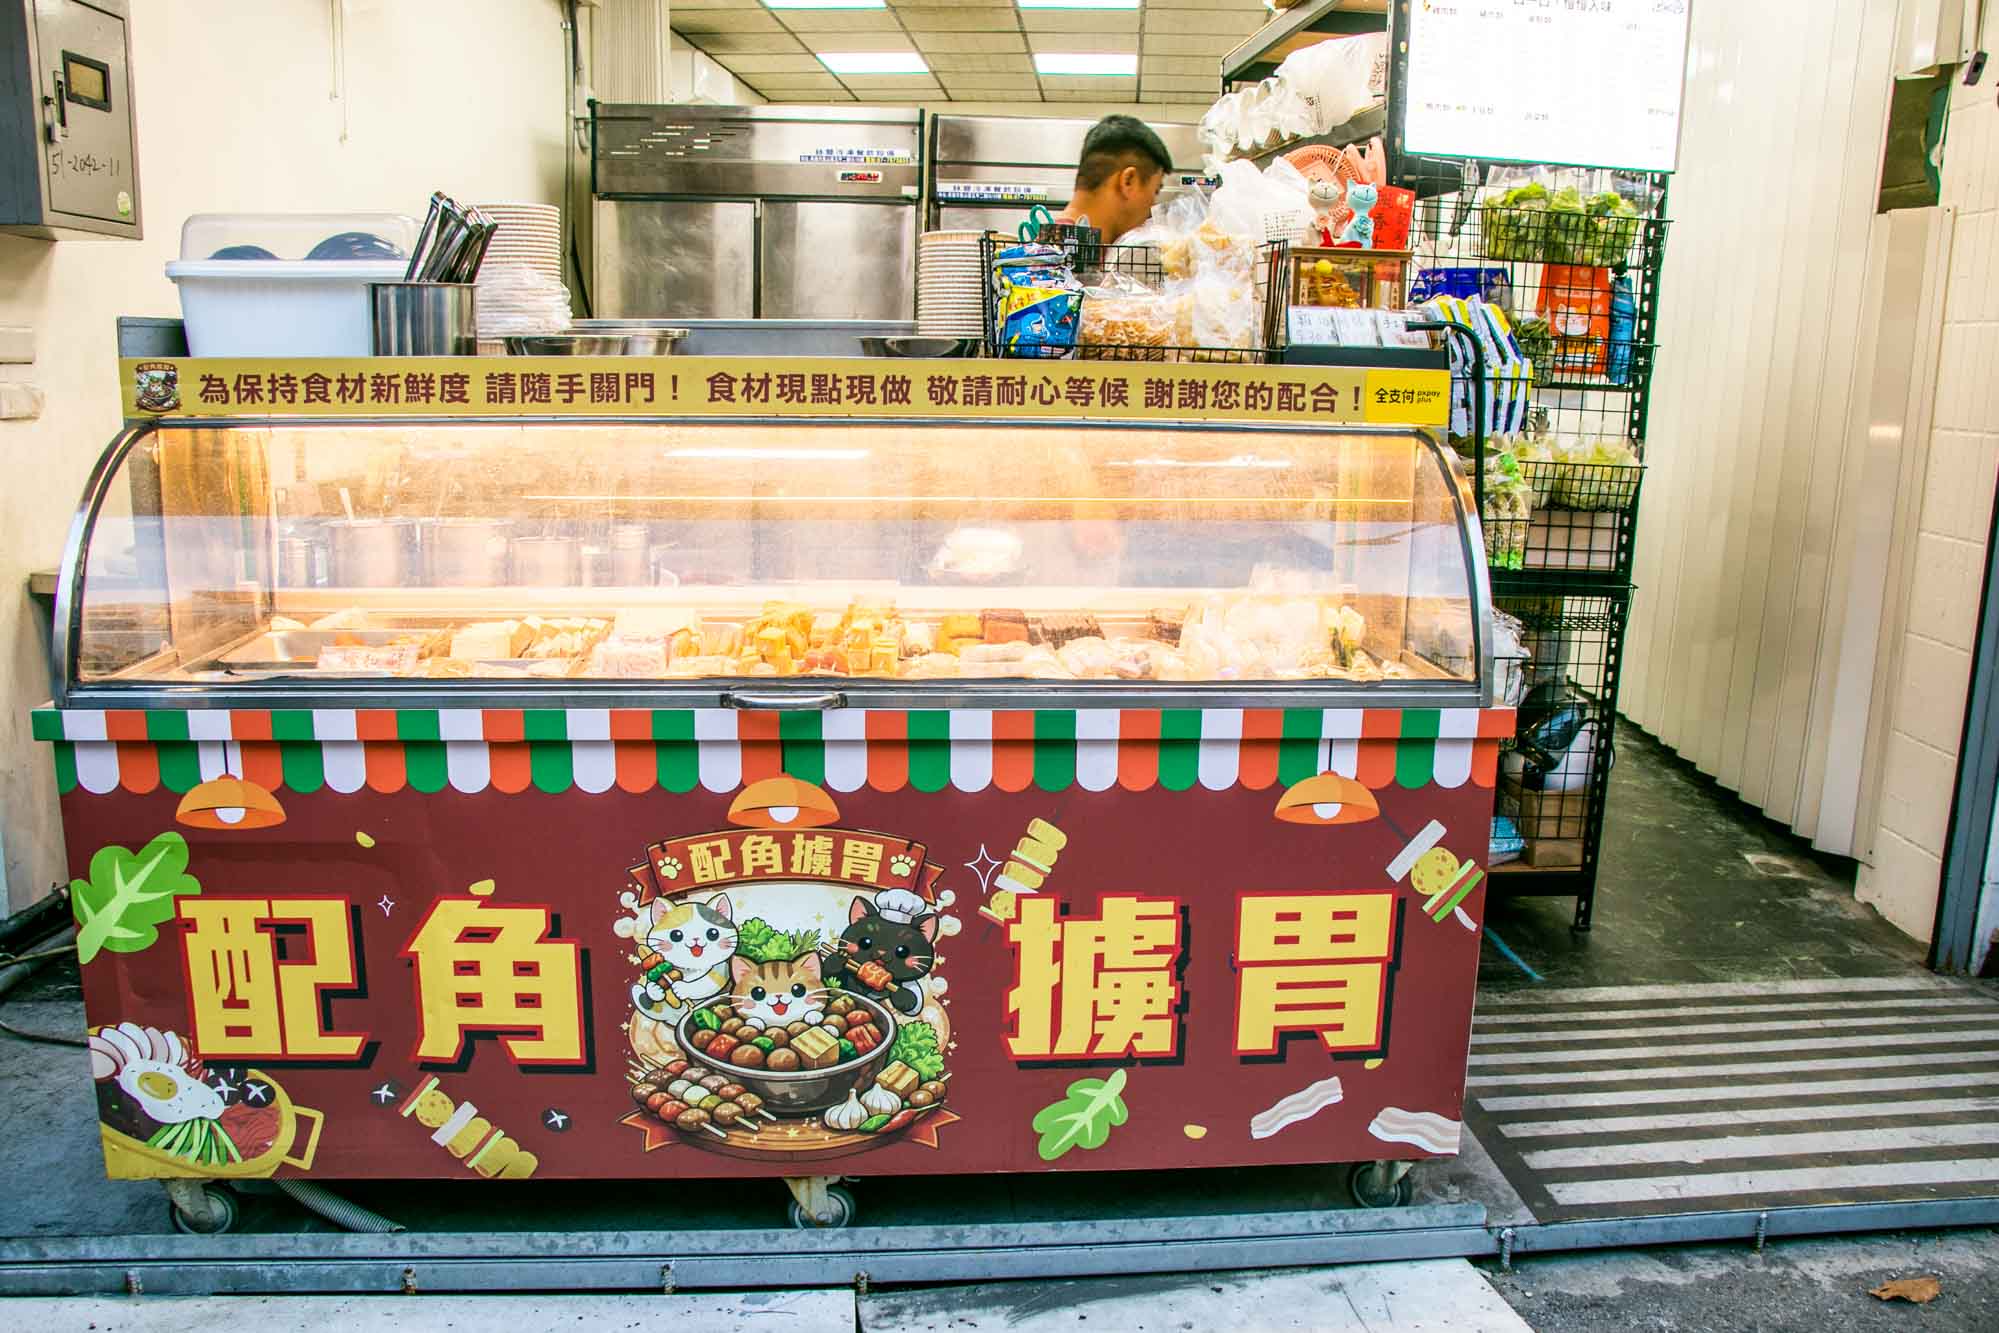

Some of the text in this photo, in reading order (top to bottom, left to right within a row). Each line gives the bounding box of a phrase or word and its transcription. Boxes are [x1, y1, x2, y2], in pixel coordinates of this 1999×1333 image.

[199, 372, 471, 405] 為保持食材新鮮度
[706, 371, 912, 406] 食材現點現做
[926, 375, 1129, 408] 敬請耐心等候
[1375, 387, 1415, 404] 全支付
[687, 833, 884, 884] 配角擄胃
[174, 895, 586, 1064] 配角
